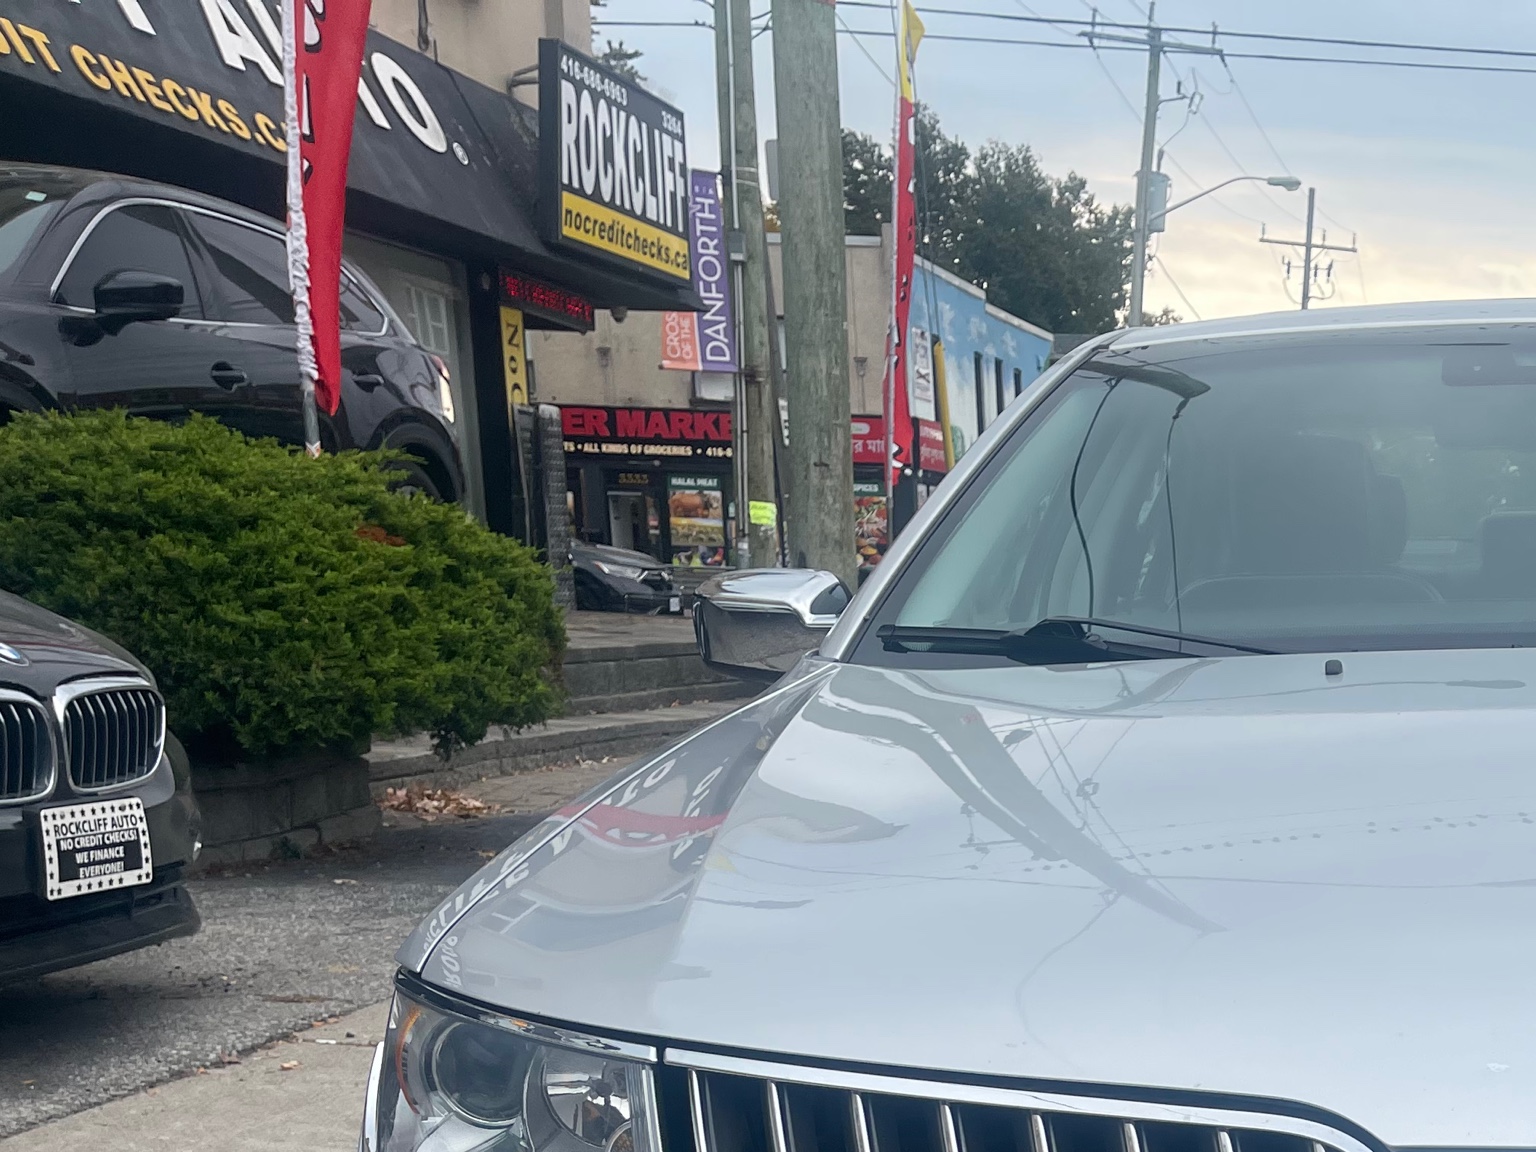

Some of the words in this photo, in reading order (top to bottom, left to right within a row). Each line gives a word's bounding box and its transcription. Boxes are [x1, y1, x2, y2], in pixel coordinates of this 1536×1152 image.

[70, 44, 290, 152] CHECKS.C
[202, 0, 447, 153] AO
[560, 79, 686, 232] ROCKCLIFF
[564, 206, 689, 271] nocreditchecks.ca
[695, 197, 731, 362] DANFORTH
[53, 817, 109, 838] ROCKCLIFF
[111, 814, 137, 829] AUTO
[60, 838, 73, 851] NO
[74, 834, 103, 849] CREDIT
[104, 829, 138, 844] CHECKS!
[75, 851, 89, 864] WE
[90, 846, 125, 861] FINANCE
[79, 861, 125, 878] EVERYONE!
